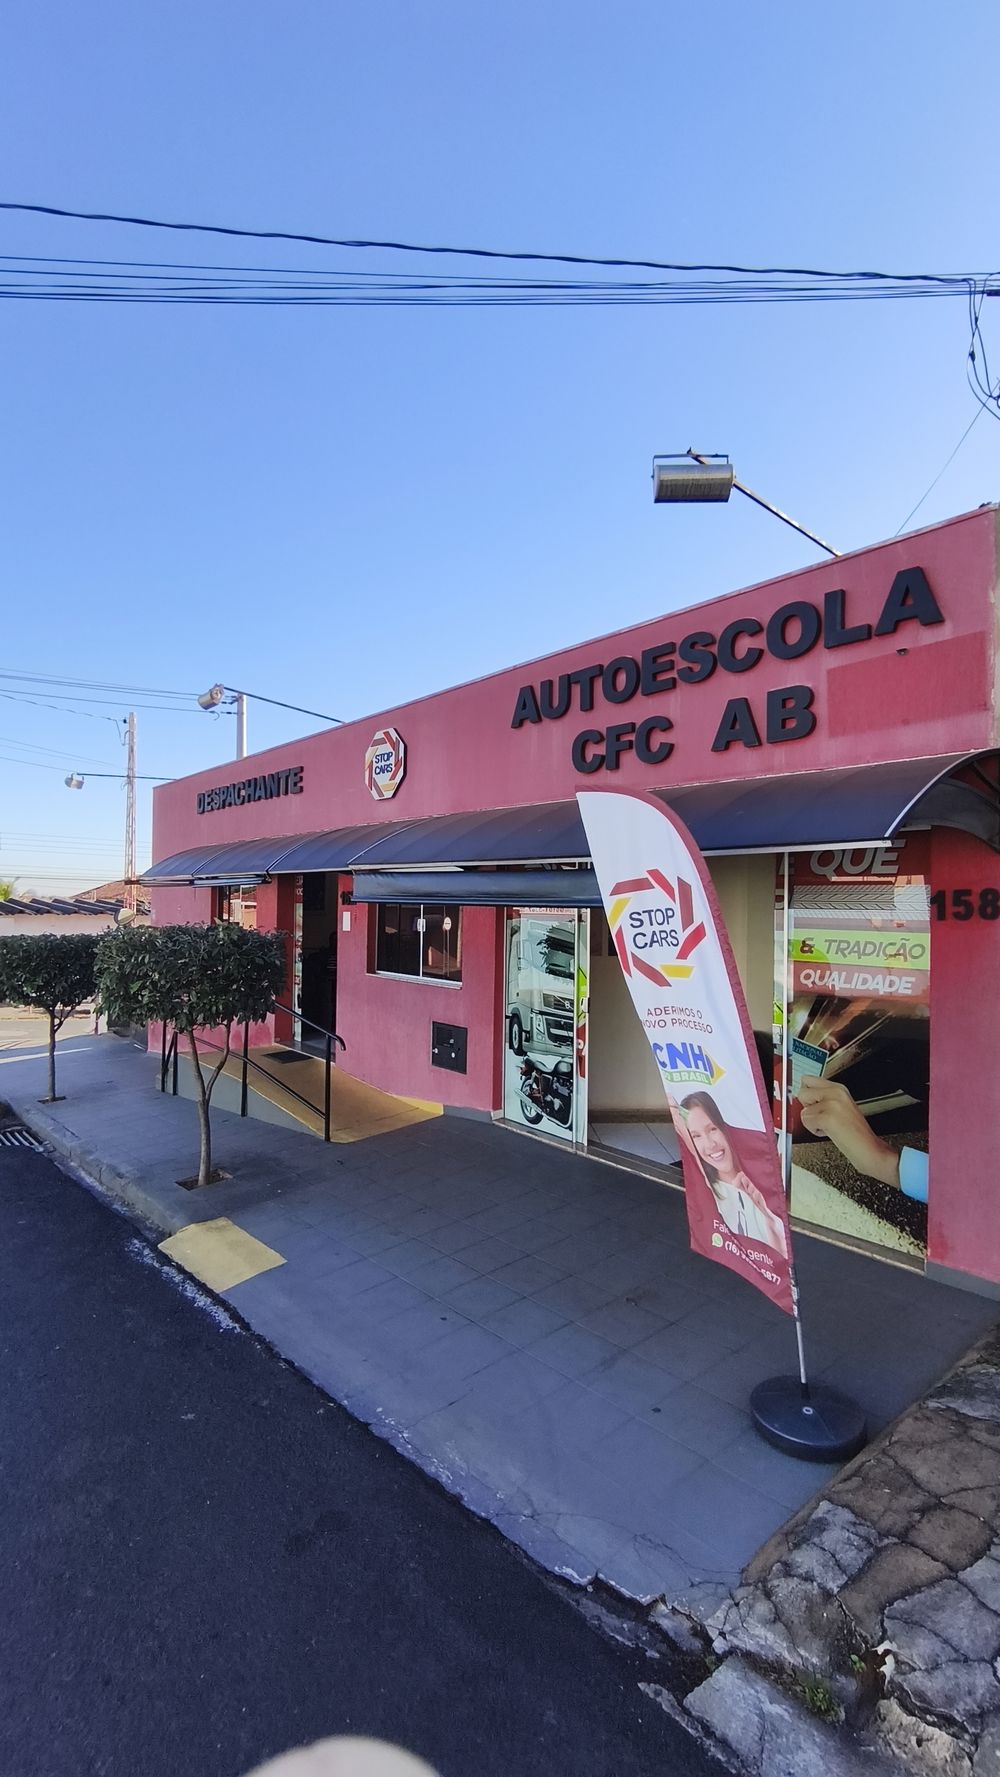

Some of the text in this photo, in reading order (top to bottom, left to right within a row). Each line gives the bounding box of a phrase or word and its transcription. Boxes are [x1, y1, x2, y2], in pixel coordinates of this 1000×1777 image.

[511, 566, 945, 729] AUTOESCOLA
[571, 685, 817, 774] CFC AB
[374, 751, 393, 764] STOP
[374, 763, 393, 775] CARS
[197, 766, 304, 814] DESPACHANTE
[809, 840, 906, 878] QUE
[929, 888, 1000, 921] 158
[629, 907, 676, 929] STOP
[632, 929, 680, 949] CARS
[824, 937, 926, 962] TRADIÇÃO
[800, 969, 916, 995] QUALIDADE
[647, 1006, 703, 1020] ADERIMOS O
[671, 1018, 713, 1034] PROCESSO
[652, 1042, 708, 1072] CNH
[673, 1072, 710, 1084] BRASIL
